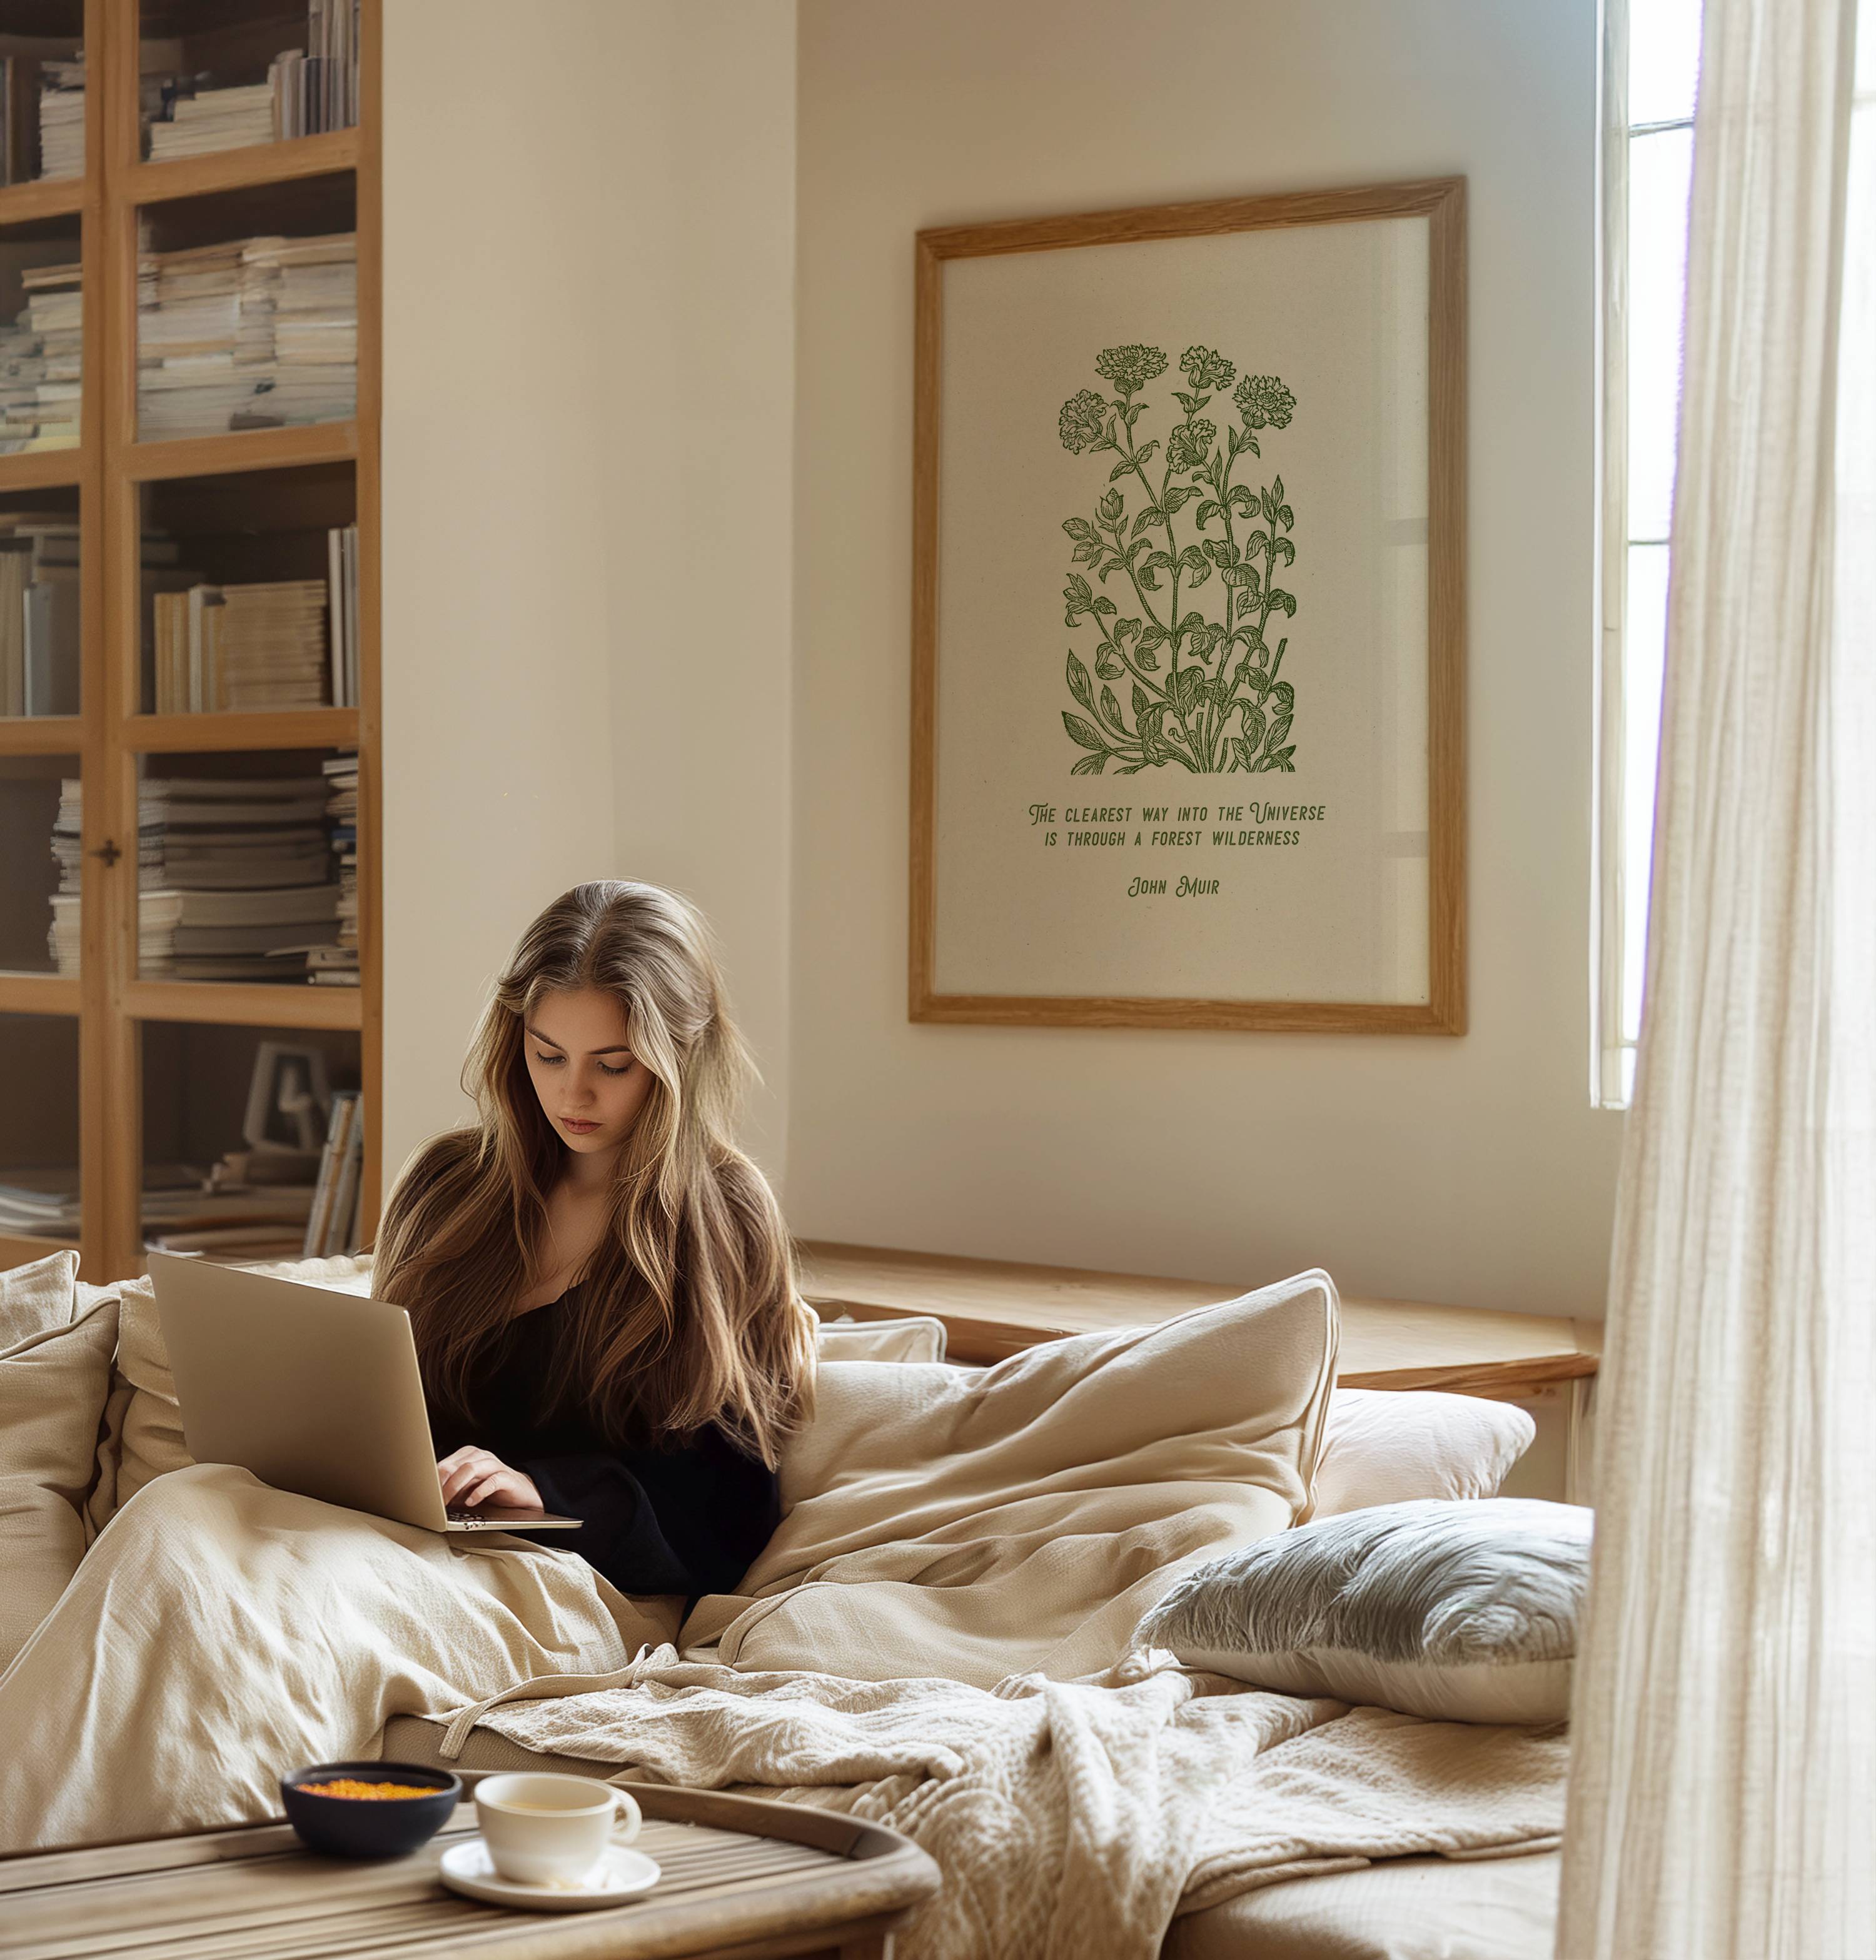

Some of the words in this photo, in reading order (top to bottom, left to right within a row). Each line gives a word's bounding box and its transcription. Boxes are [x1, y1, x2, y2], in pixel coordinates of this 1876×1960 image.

[1029, 803, 1057, 826] THE
[1065, 807, 1132, 823] CLEAREST
[1142, 807, 1169, 822] WAY
[1178, 807, 1208, 822] INTO
[1218, 807, 1244, 822] THE
[1249, 802, 1326, 824] UNIVERSE
[1045, 832, 1057, 847] IS
[1067, 832, 1126, 846] THROUGH
[1134, 832, 1141, 846] A
[1151, 831, 1203, 846] FOREST
[1213, 830, 1300, 846] WILDERNESS
[1127, 877, 1167, 898] JOHN
[1175, 875, 1220, 898] MUIR
